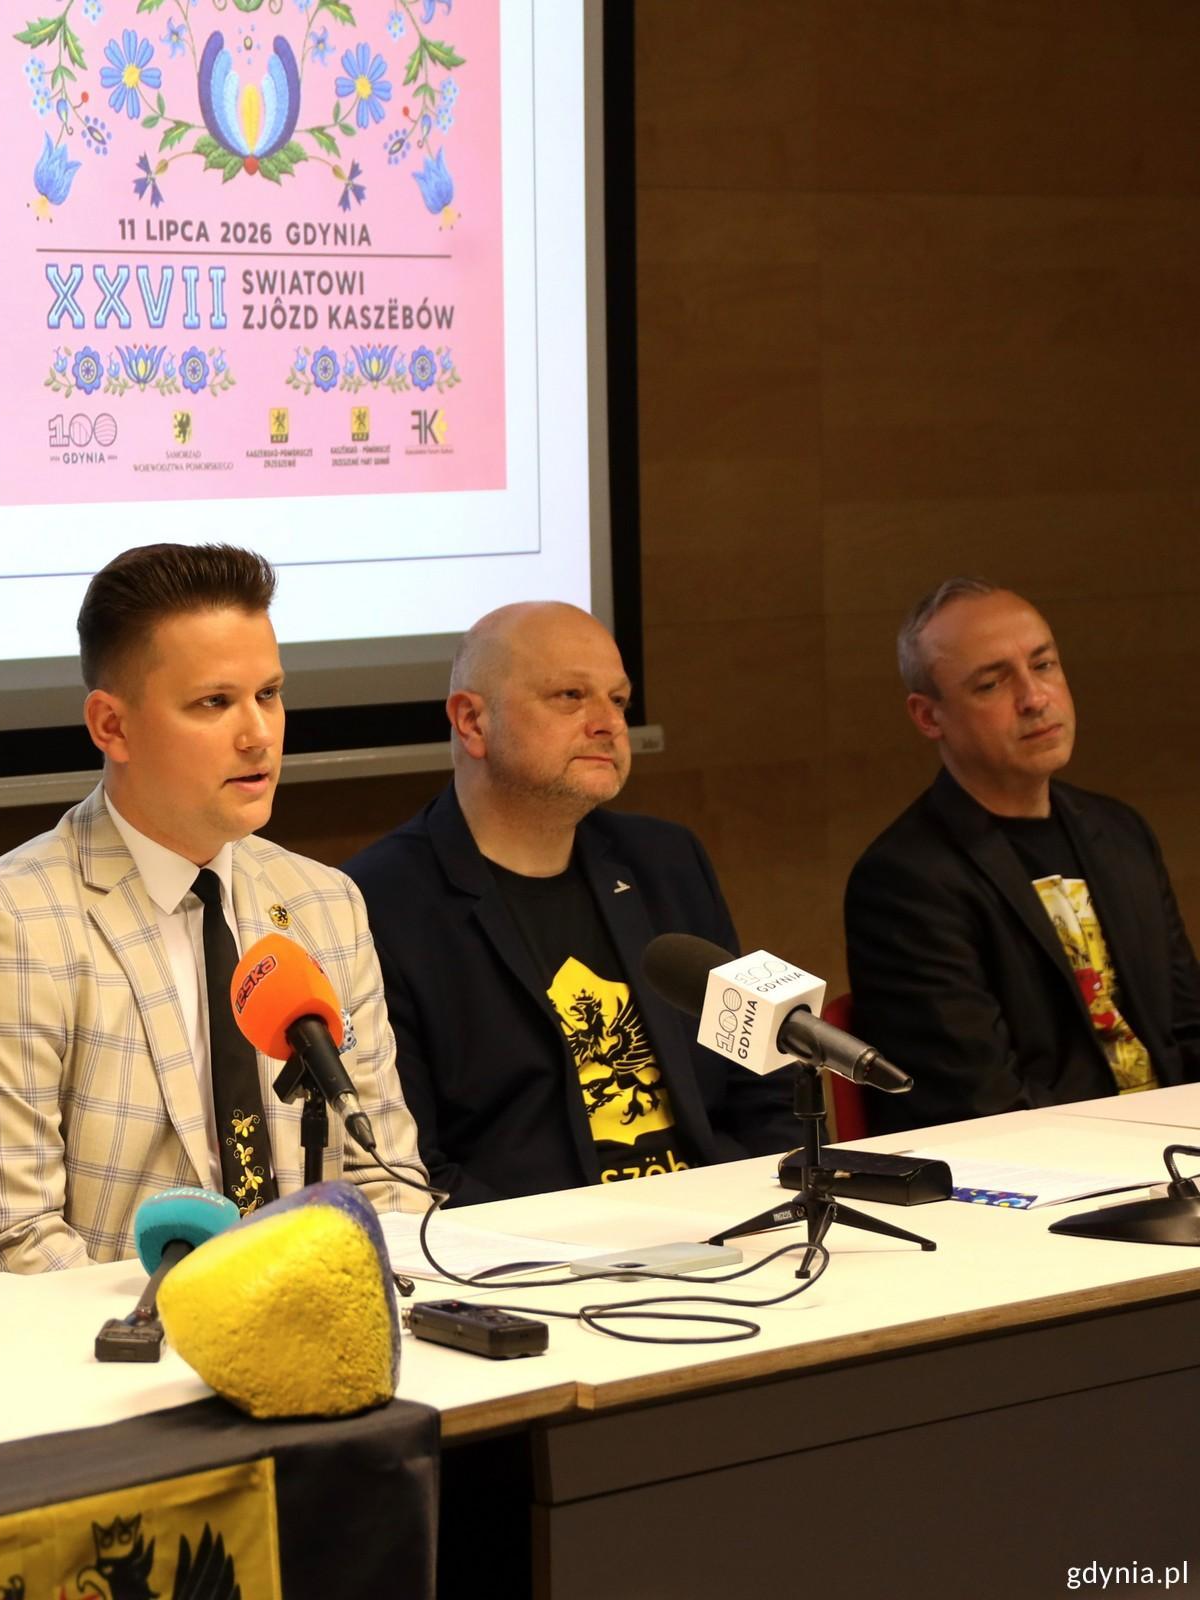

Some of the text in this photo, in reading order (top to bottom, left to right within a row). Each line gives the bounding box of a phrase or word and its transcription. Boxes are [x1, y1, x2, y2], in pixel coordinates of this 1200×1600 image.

[119, 219, 371, 246] 11 LIPCA 2026 GDYNIA
[45, 264, 227, 329] XXVII
[242, 270, 364, 296] SWIATOWI
[242, 296, 455, 330] ZJÔZD KASZËBÓW
[48, 413, 117, 447] 100
[63, 453, 104, 464] GDYNIA
[756, 971, 805, 993] GDYNIA
[715, 987, 743, 1053] 100
[738, 999, 758, 1060] GDYNIA
